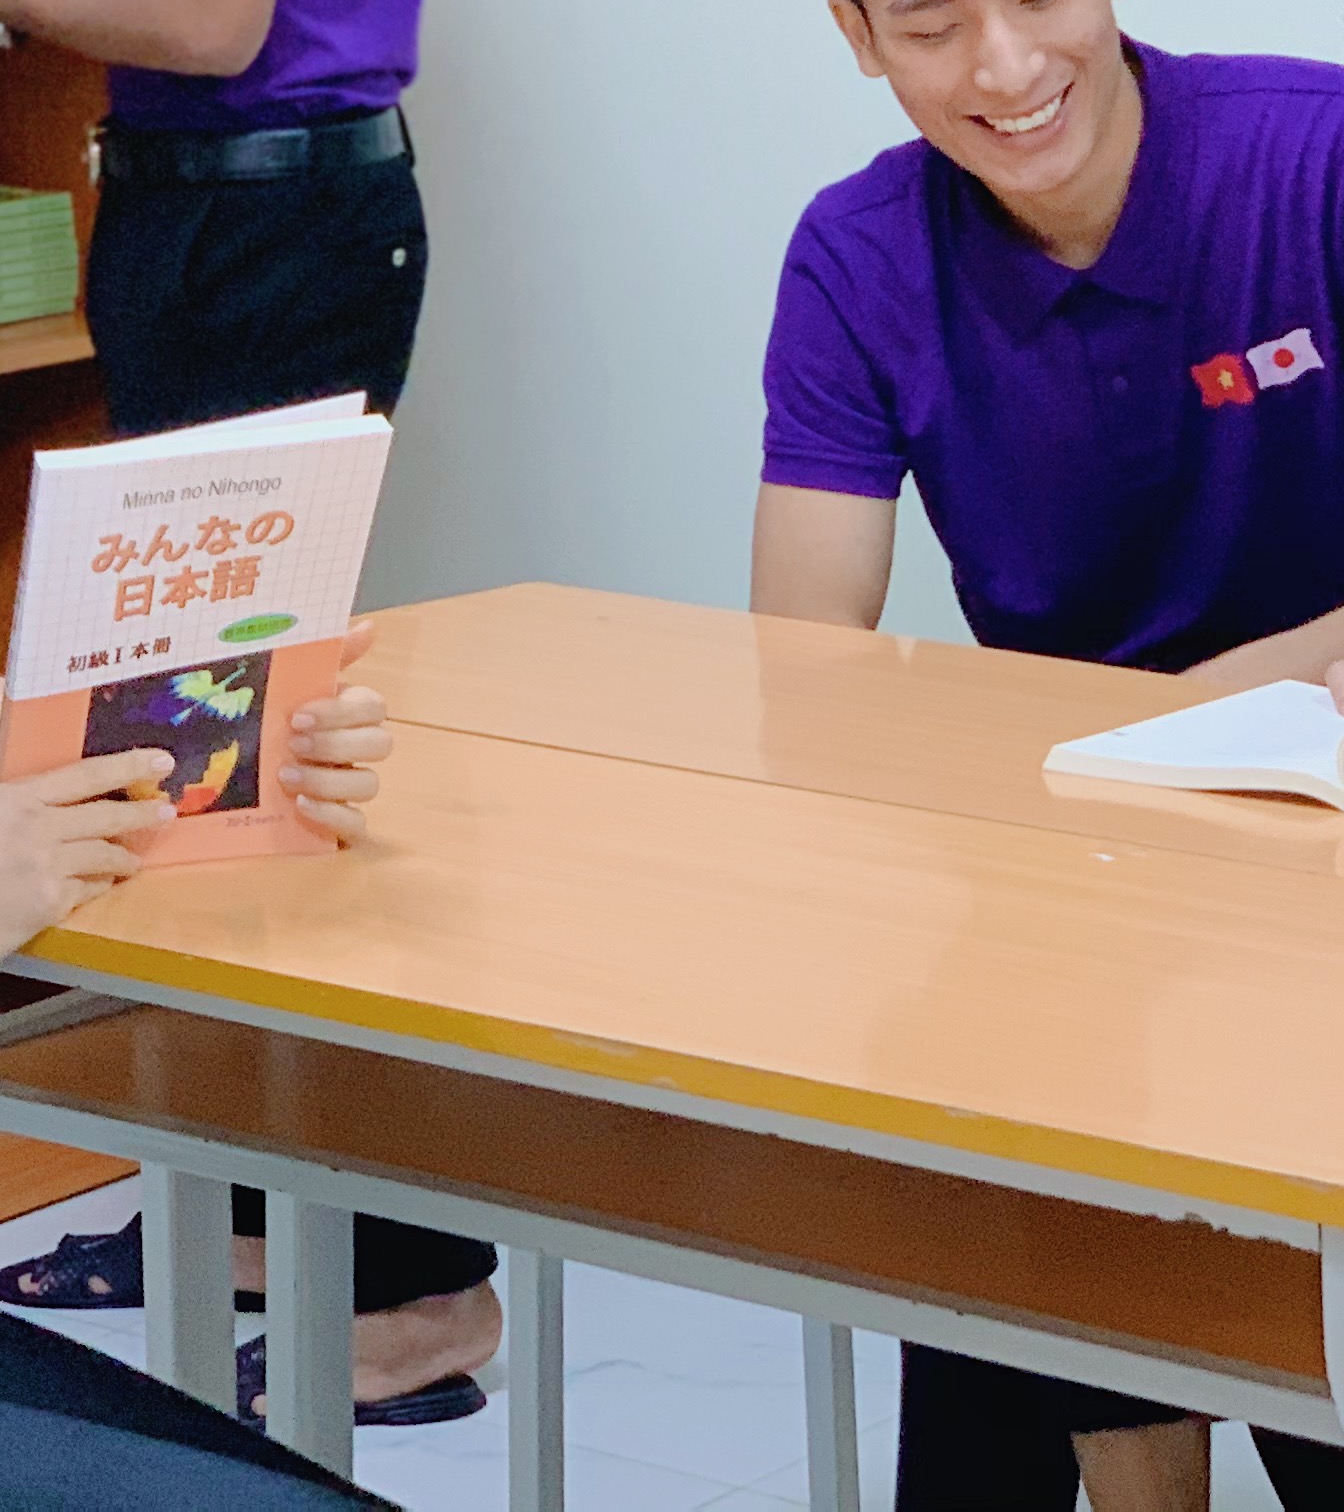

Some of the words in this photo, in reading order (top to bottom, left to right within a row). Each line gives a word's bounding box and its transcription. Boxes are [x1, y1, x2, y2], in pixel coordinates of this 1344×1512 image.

[123, 489, 175, 509] Minna
[181, 485, 203, 501] no
[208, 477, 282, 497] Nihongo
[91, 510, 295, 573] みんなの
[114, 555, 262, 622] 日本語
